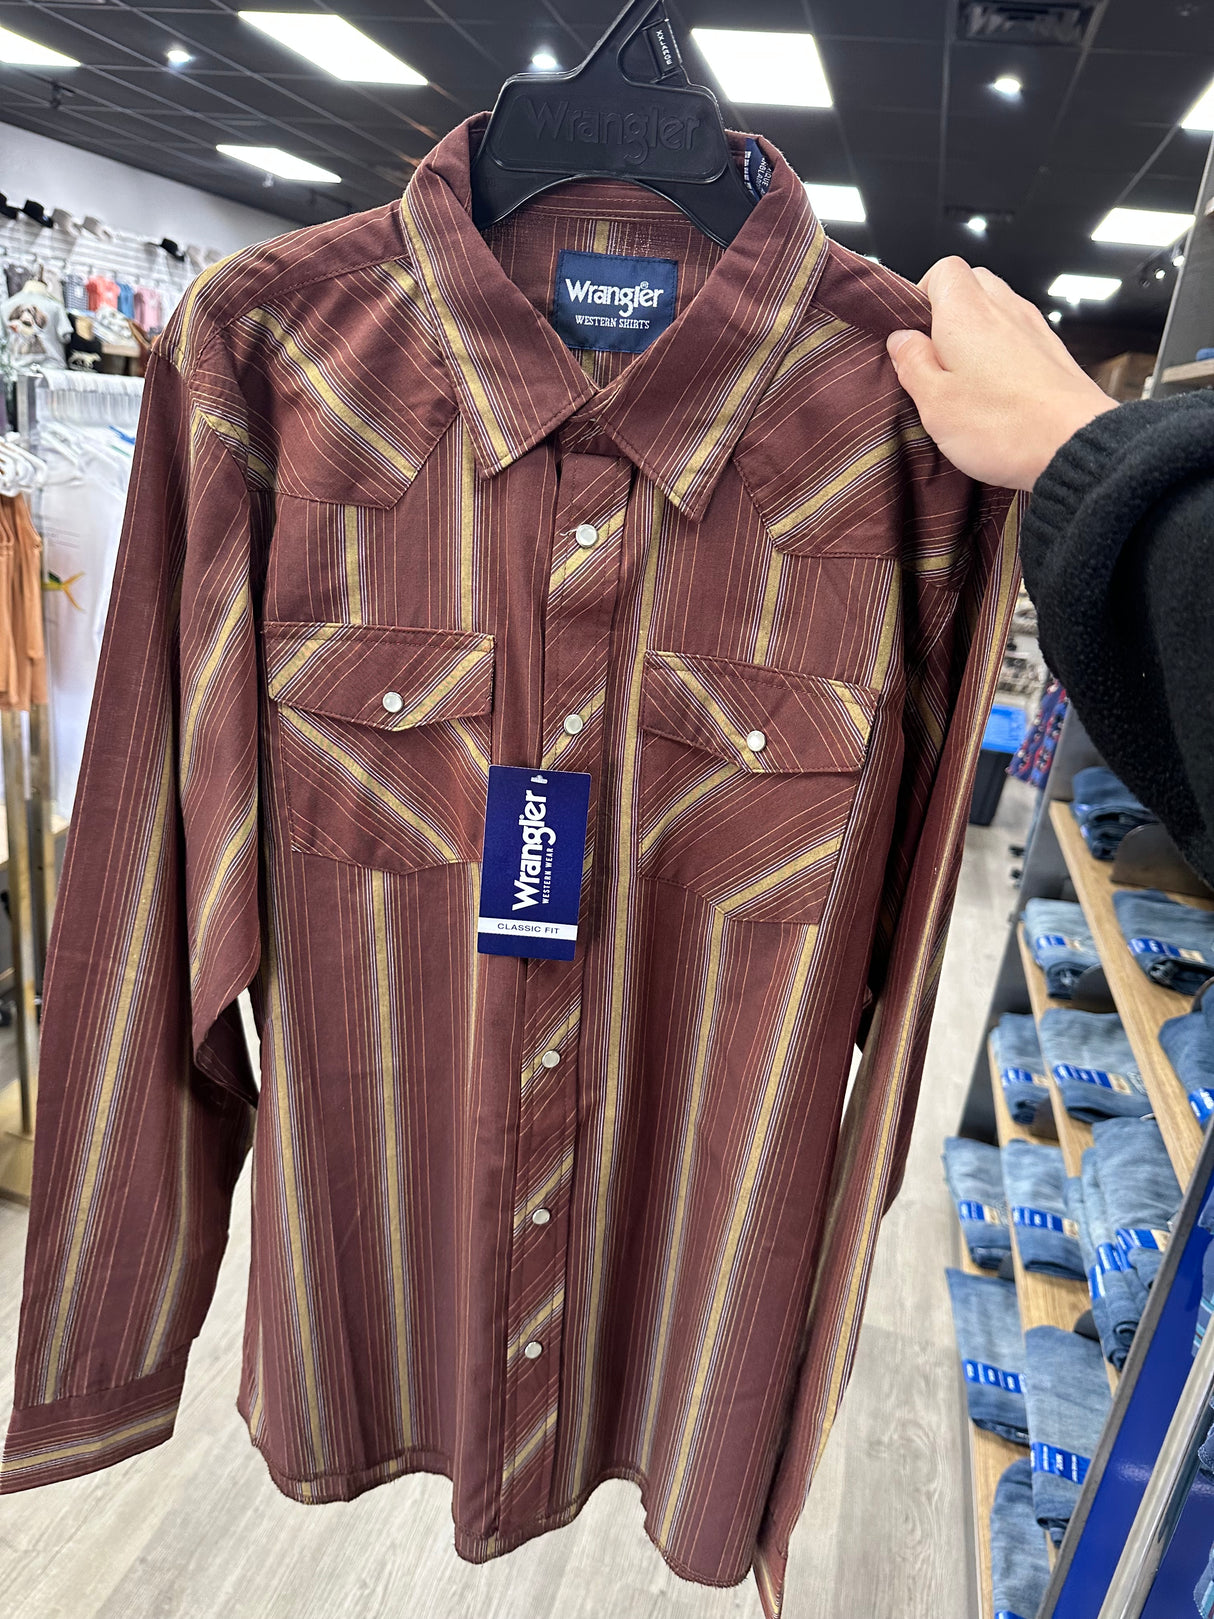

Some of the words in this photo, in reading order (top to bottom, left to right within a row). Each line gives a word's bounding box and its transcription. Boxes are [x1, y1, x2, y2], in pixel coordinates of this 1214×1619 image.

[528, 96, 701, 165] Wrangler
[565, 278, 664, 318] Wrangler
[575, 314, 617, 328] WESTERN
[618, 318, 650, 330] SHIRTS
[511, 789, 557, 911] Wrangler
[546, 847, 554, 868] WEAR
[542, 869, 552, 904] WESTERN
[497, 922, 541, 933] CLASSIC
[544, 926, 560, 935] FIT
